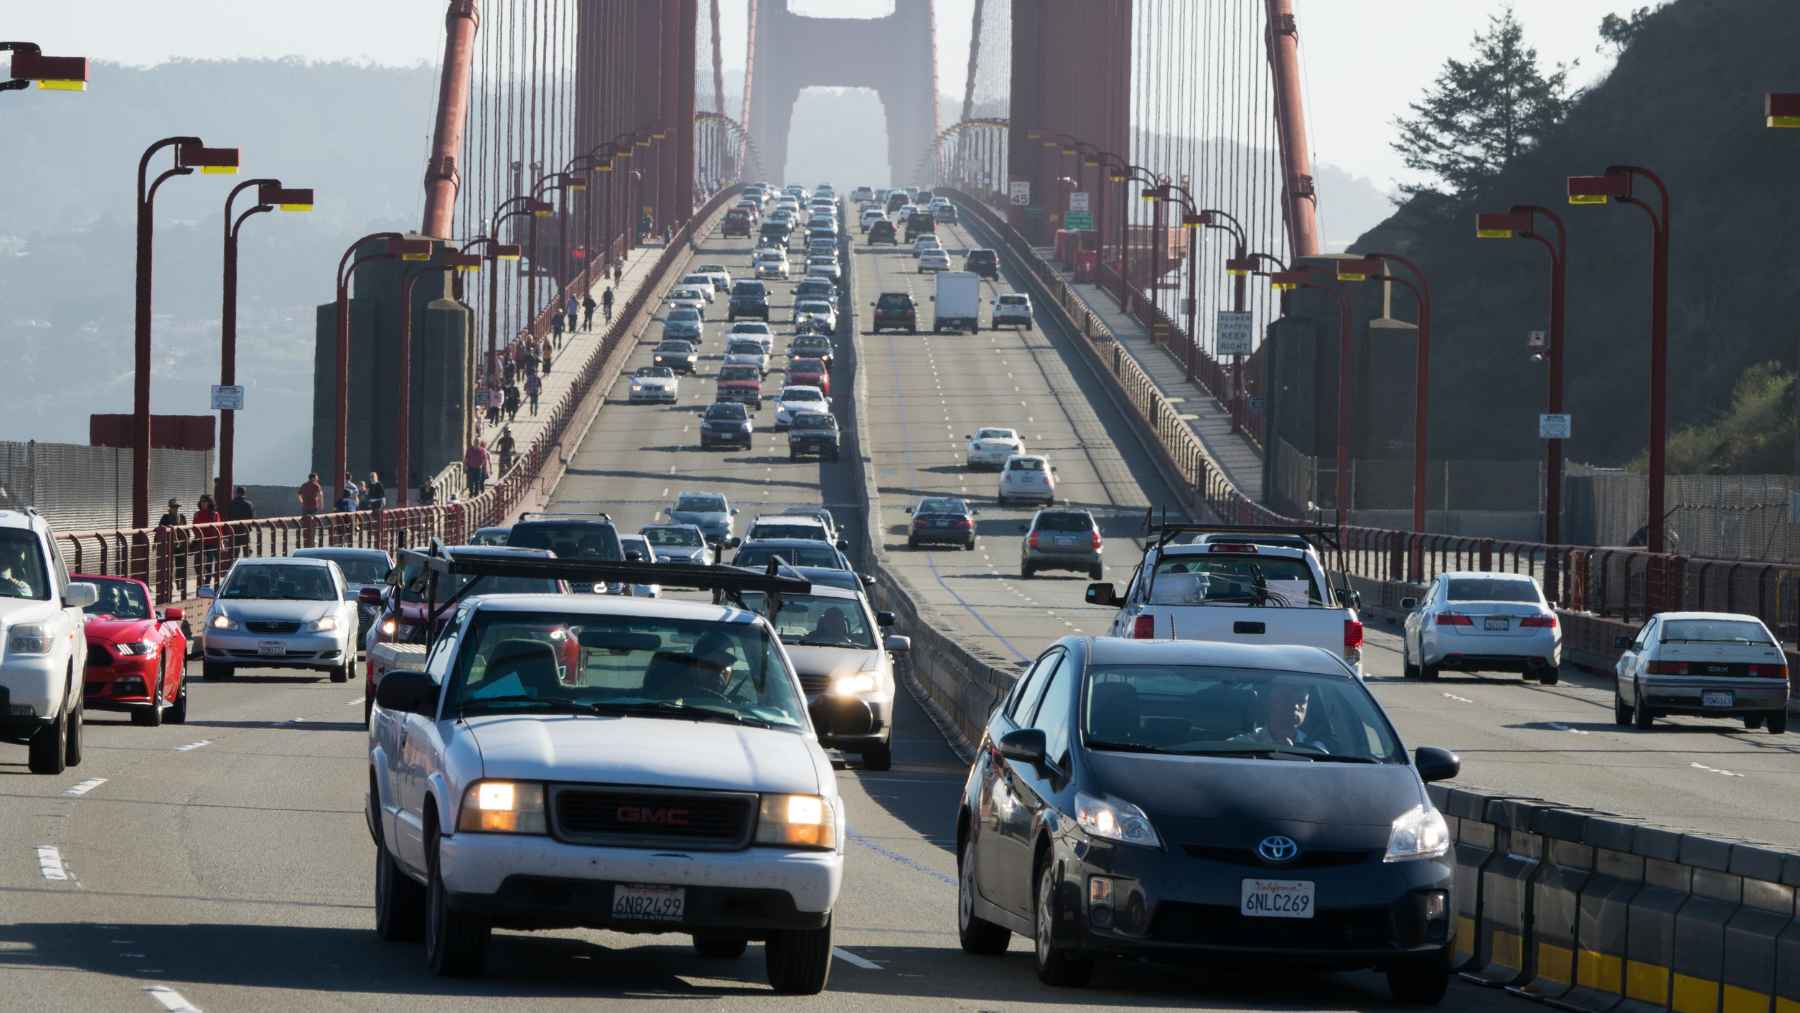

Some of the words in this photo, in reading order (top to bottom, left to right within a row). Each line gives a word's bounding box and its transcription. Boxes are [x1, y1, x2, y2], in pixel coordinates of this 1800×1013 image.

[1222, 332, 1248, 340] KEEP
[616, 806, 689, 826] GMC
[1246, 893, 1310, 913] 6NLC269
